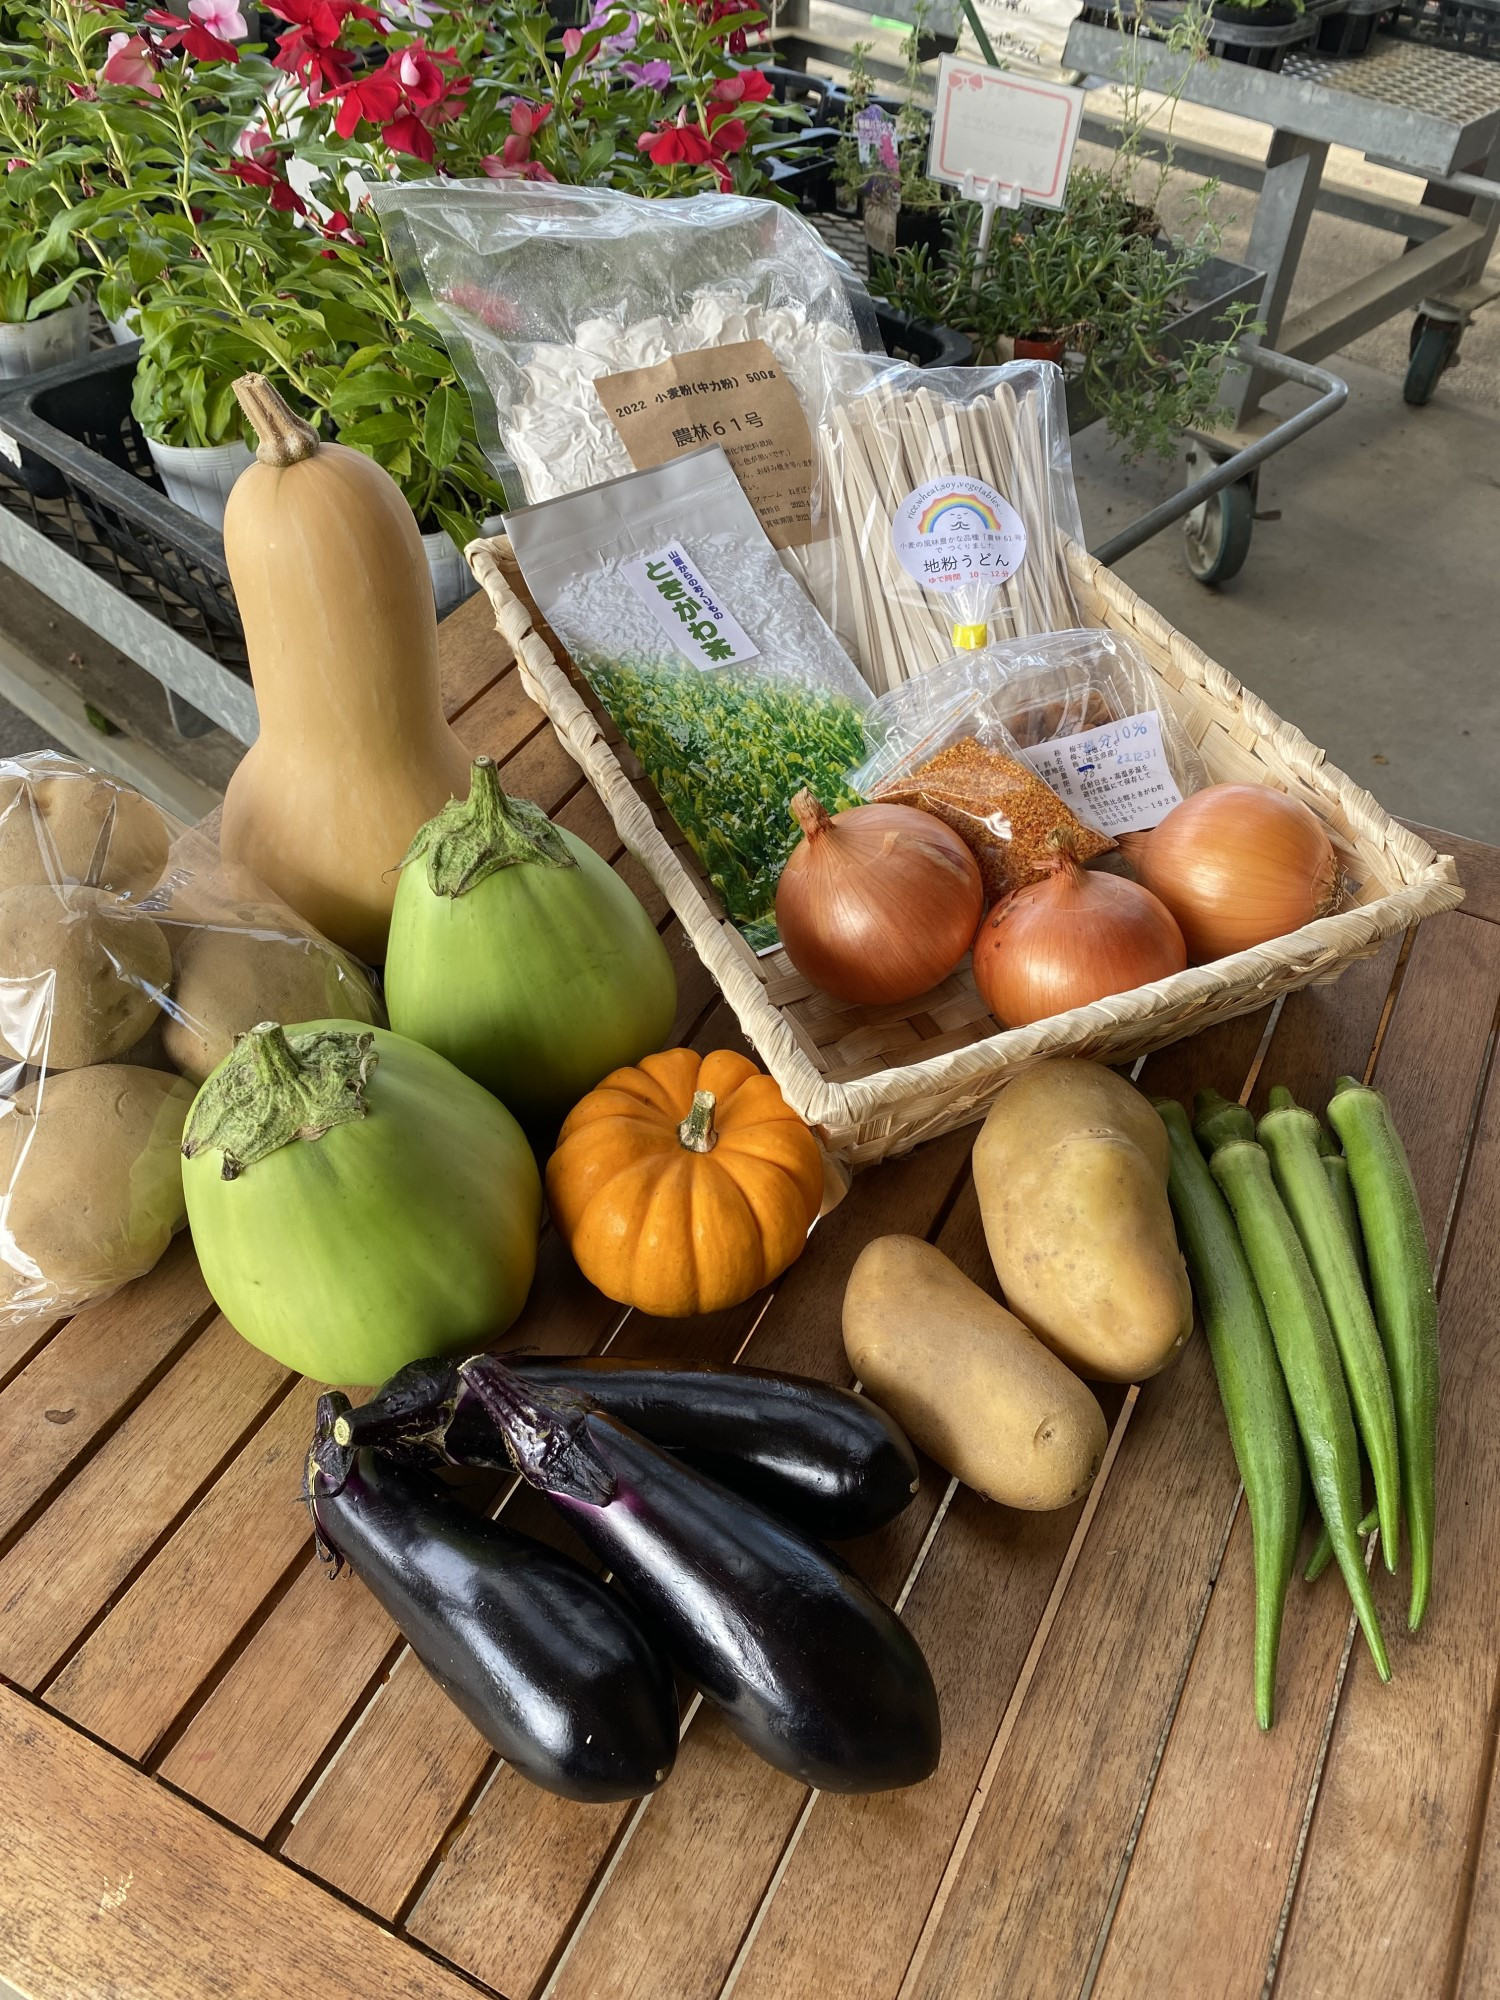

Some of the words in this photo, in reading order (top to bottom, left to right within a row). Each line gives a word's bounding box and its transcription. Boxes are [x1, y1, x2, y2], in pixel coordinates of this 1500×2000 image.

[615, 401, 648, 418] 2022
[746, 369, 776, 384] 500g
[672, 411, 764, 448] 農林61号
[923, 552, 1010, 574] 地粉うどん
[644, 560, 736, 662] ときがわ米
